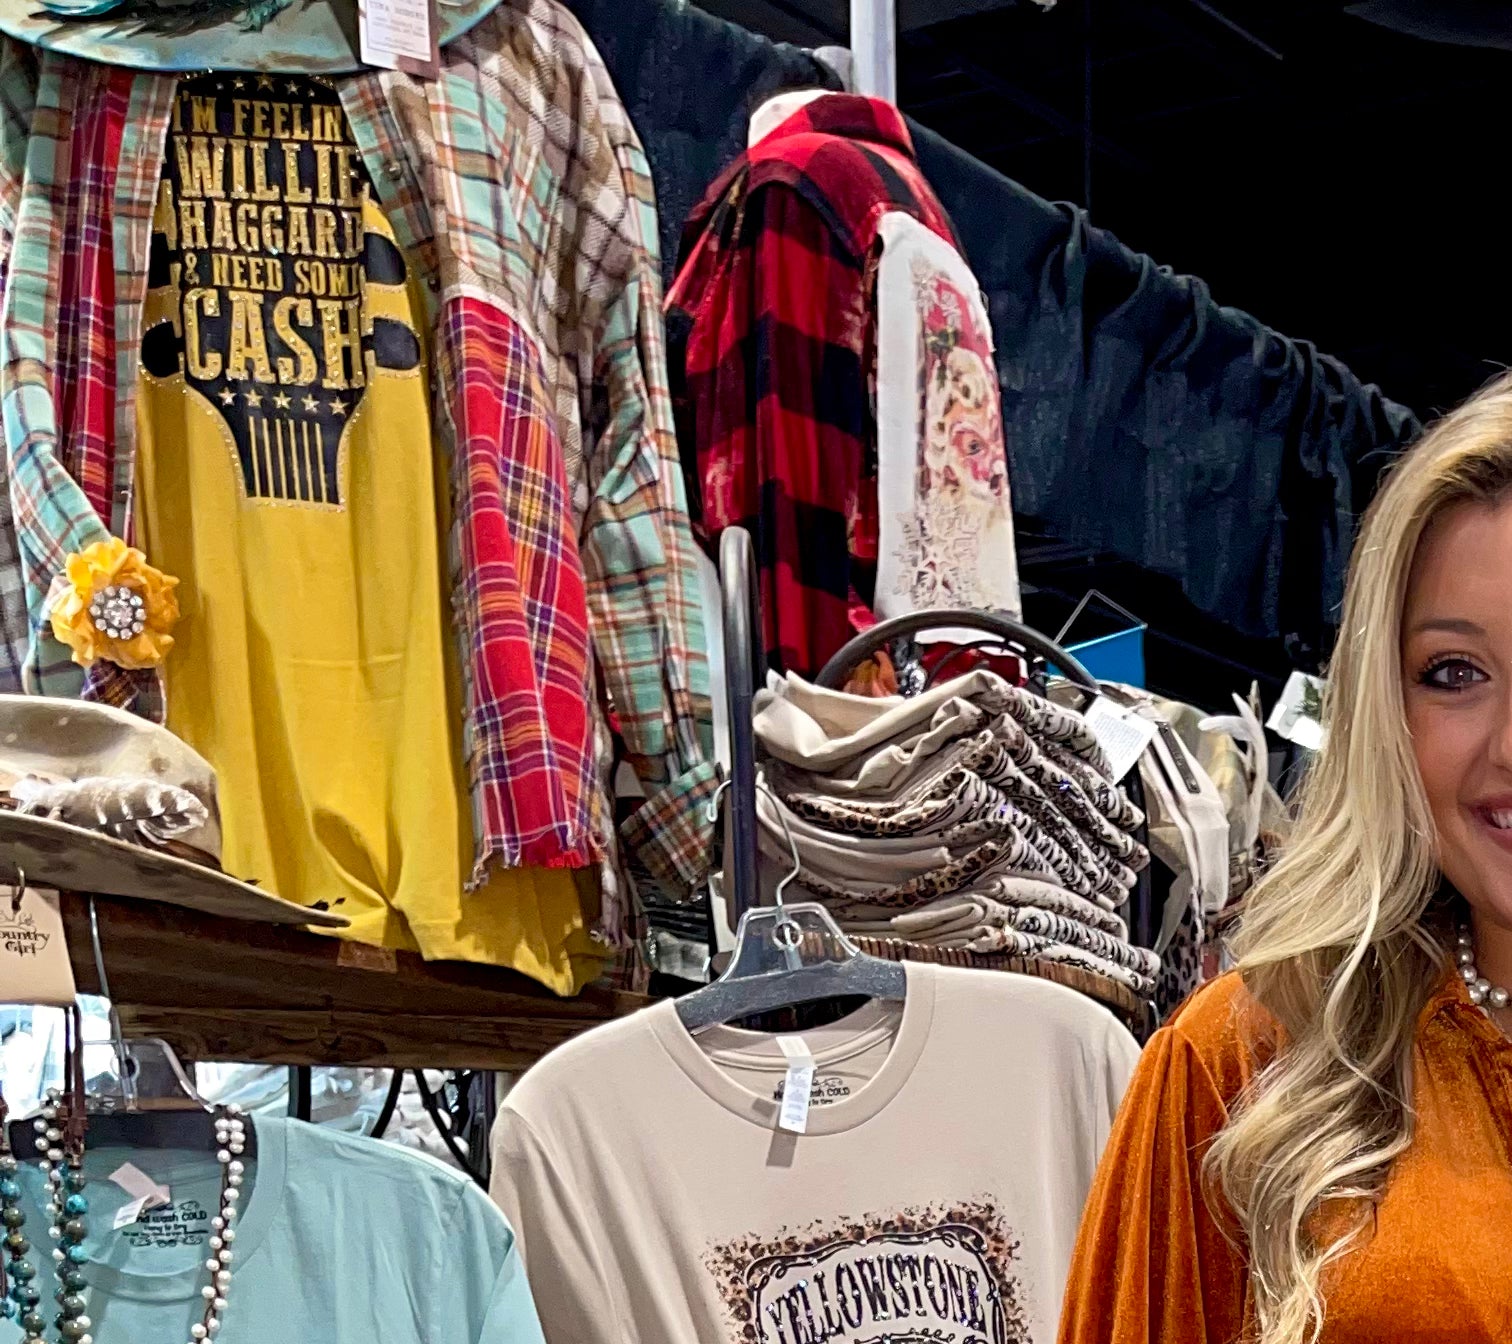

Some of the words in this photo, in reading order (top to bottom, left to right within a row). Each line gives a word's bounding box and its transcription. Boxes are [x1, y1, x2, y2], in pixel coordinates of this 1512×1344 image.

[172, 91, 218, 134] I'M
[174, 135, 370, 209] WILLIE
[178, 199, 365, 259] HAGGARD
[184, 252, 200, 285] &
[211, 252, 284, 293] NEED
[182, 287, 366, 391] CASH
[0, 928, 50, 950] ountry
